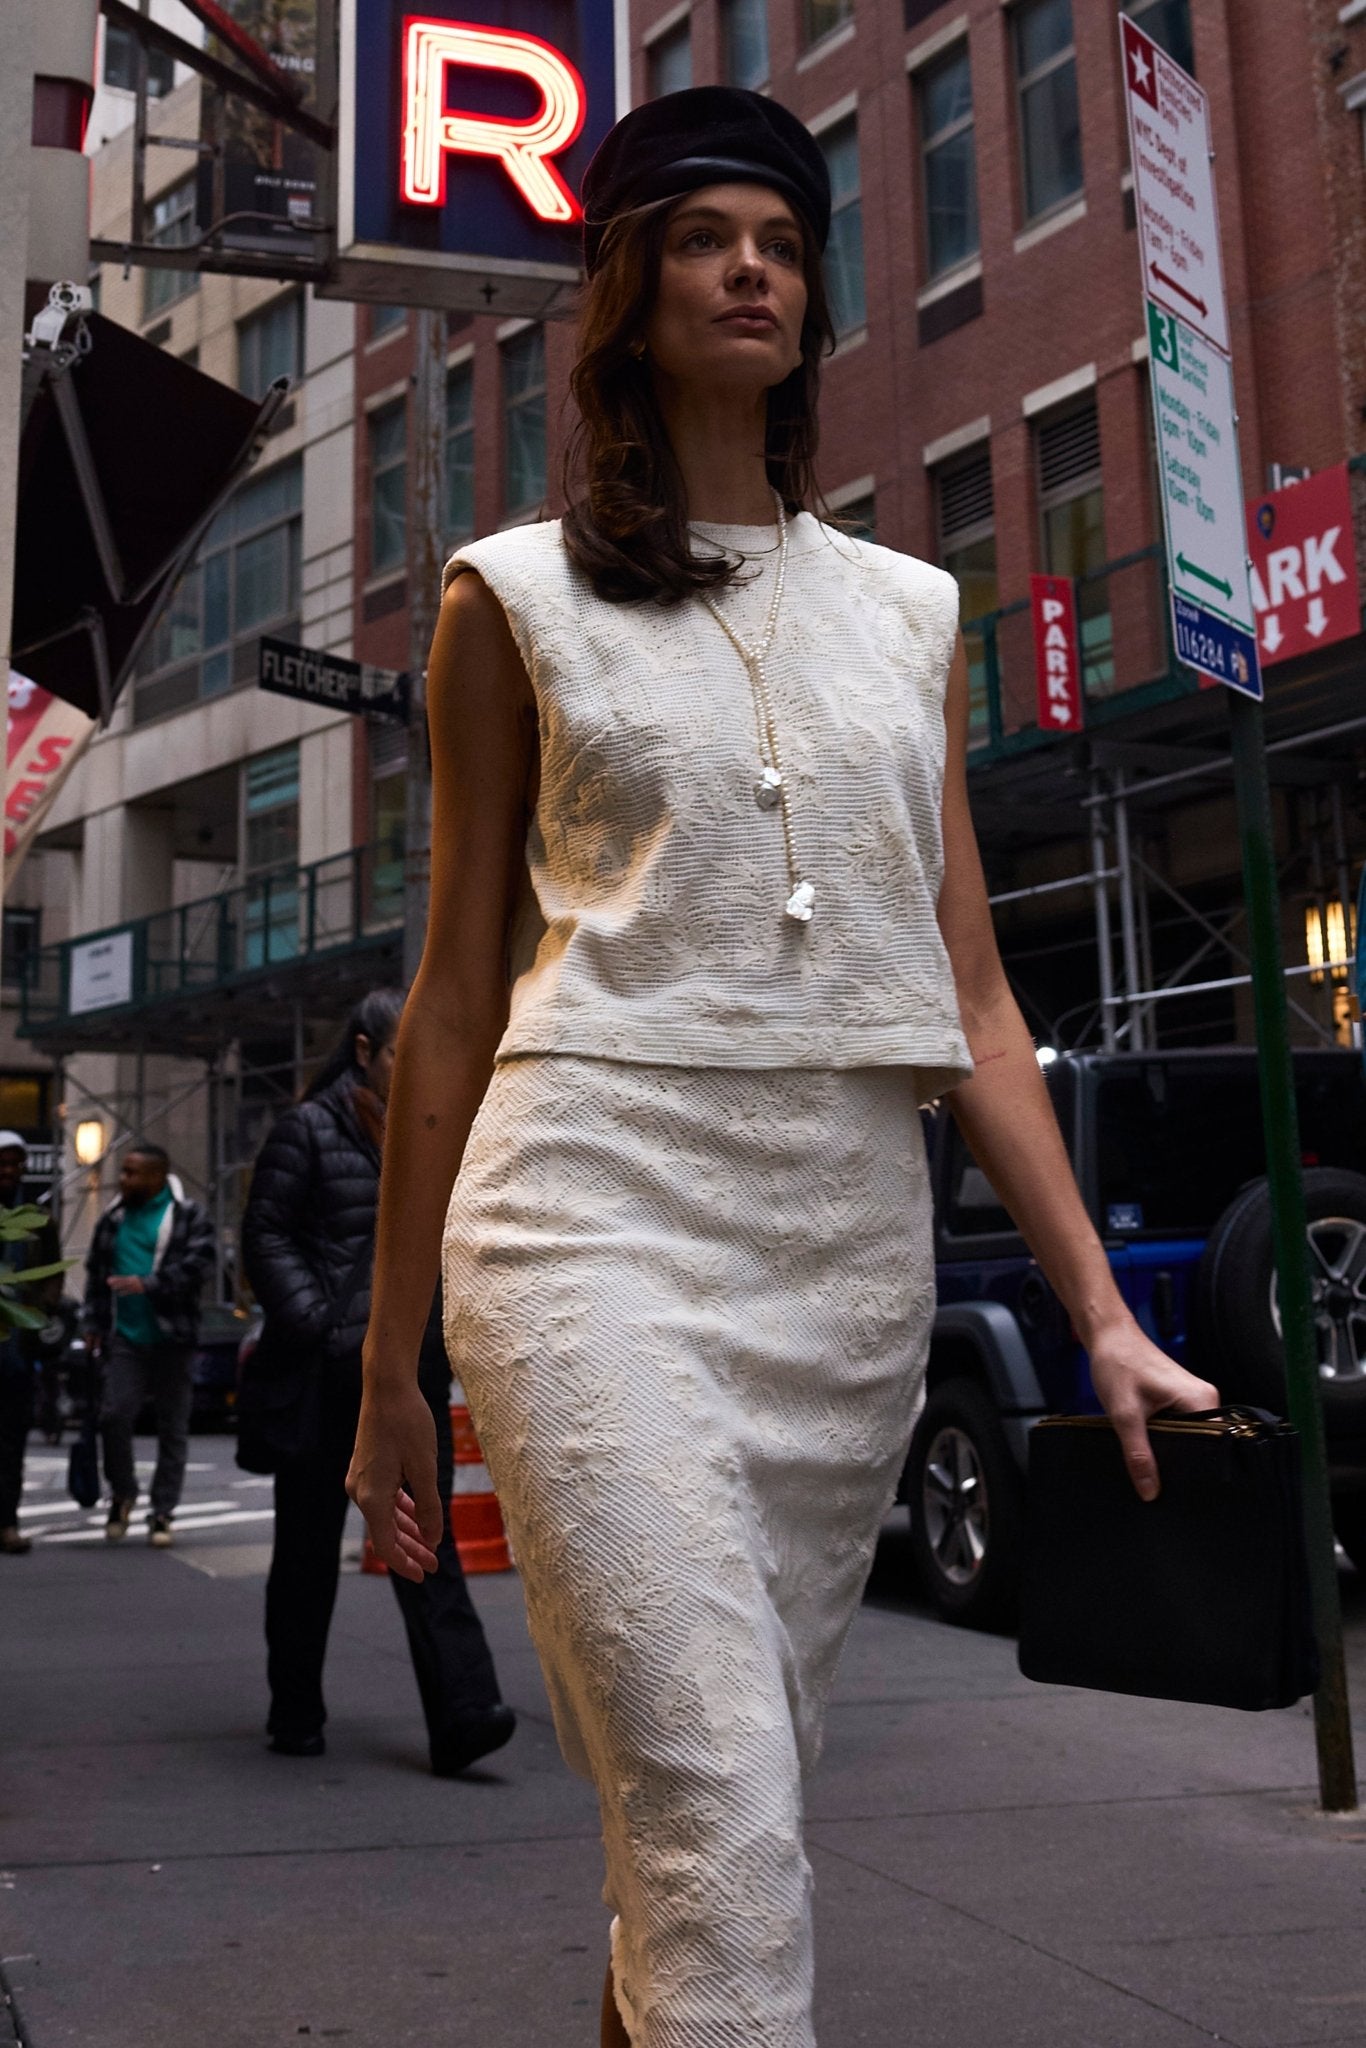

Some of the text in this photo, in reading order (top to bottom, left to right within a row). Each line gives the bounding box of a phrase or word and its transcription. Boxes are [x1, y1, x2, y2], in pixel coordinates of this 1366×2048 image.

[401, 14, 587, 225] R
[1135, 116, 1154, 146] NYC
[1138, 148, 1196, 211] Investigation
[1141, 200, 1174, 241] Monday
[1180, 229, 1205, 268] Friday
[1156, 309, 1172, 363] 3
[1159, 385, 1191, 426] Monday
[1197, 411, 1221, 447] Friday
[1165, 450, 1201, 494] Saturday
[262, 650, 349, 701] FLETCHER
[1042, 598, 1071, 700] PARK
[1177, 622, 1226, 673] 116284
